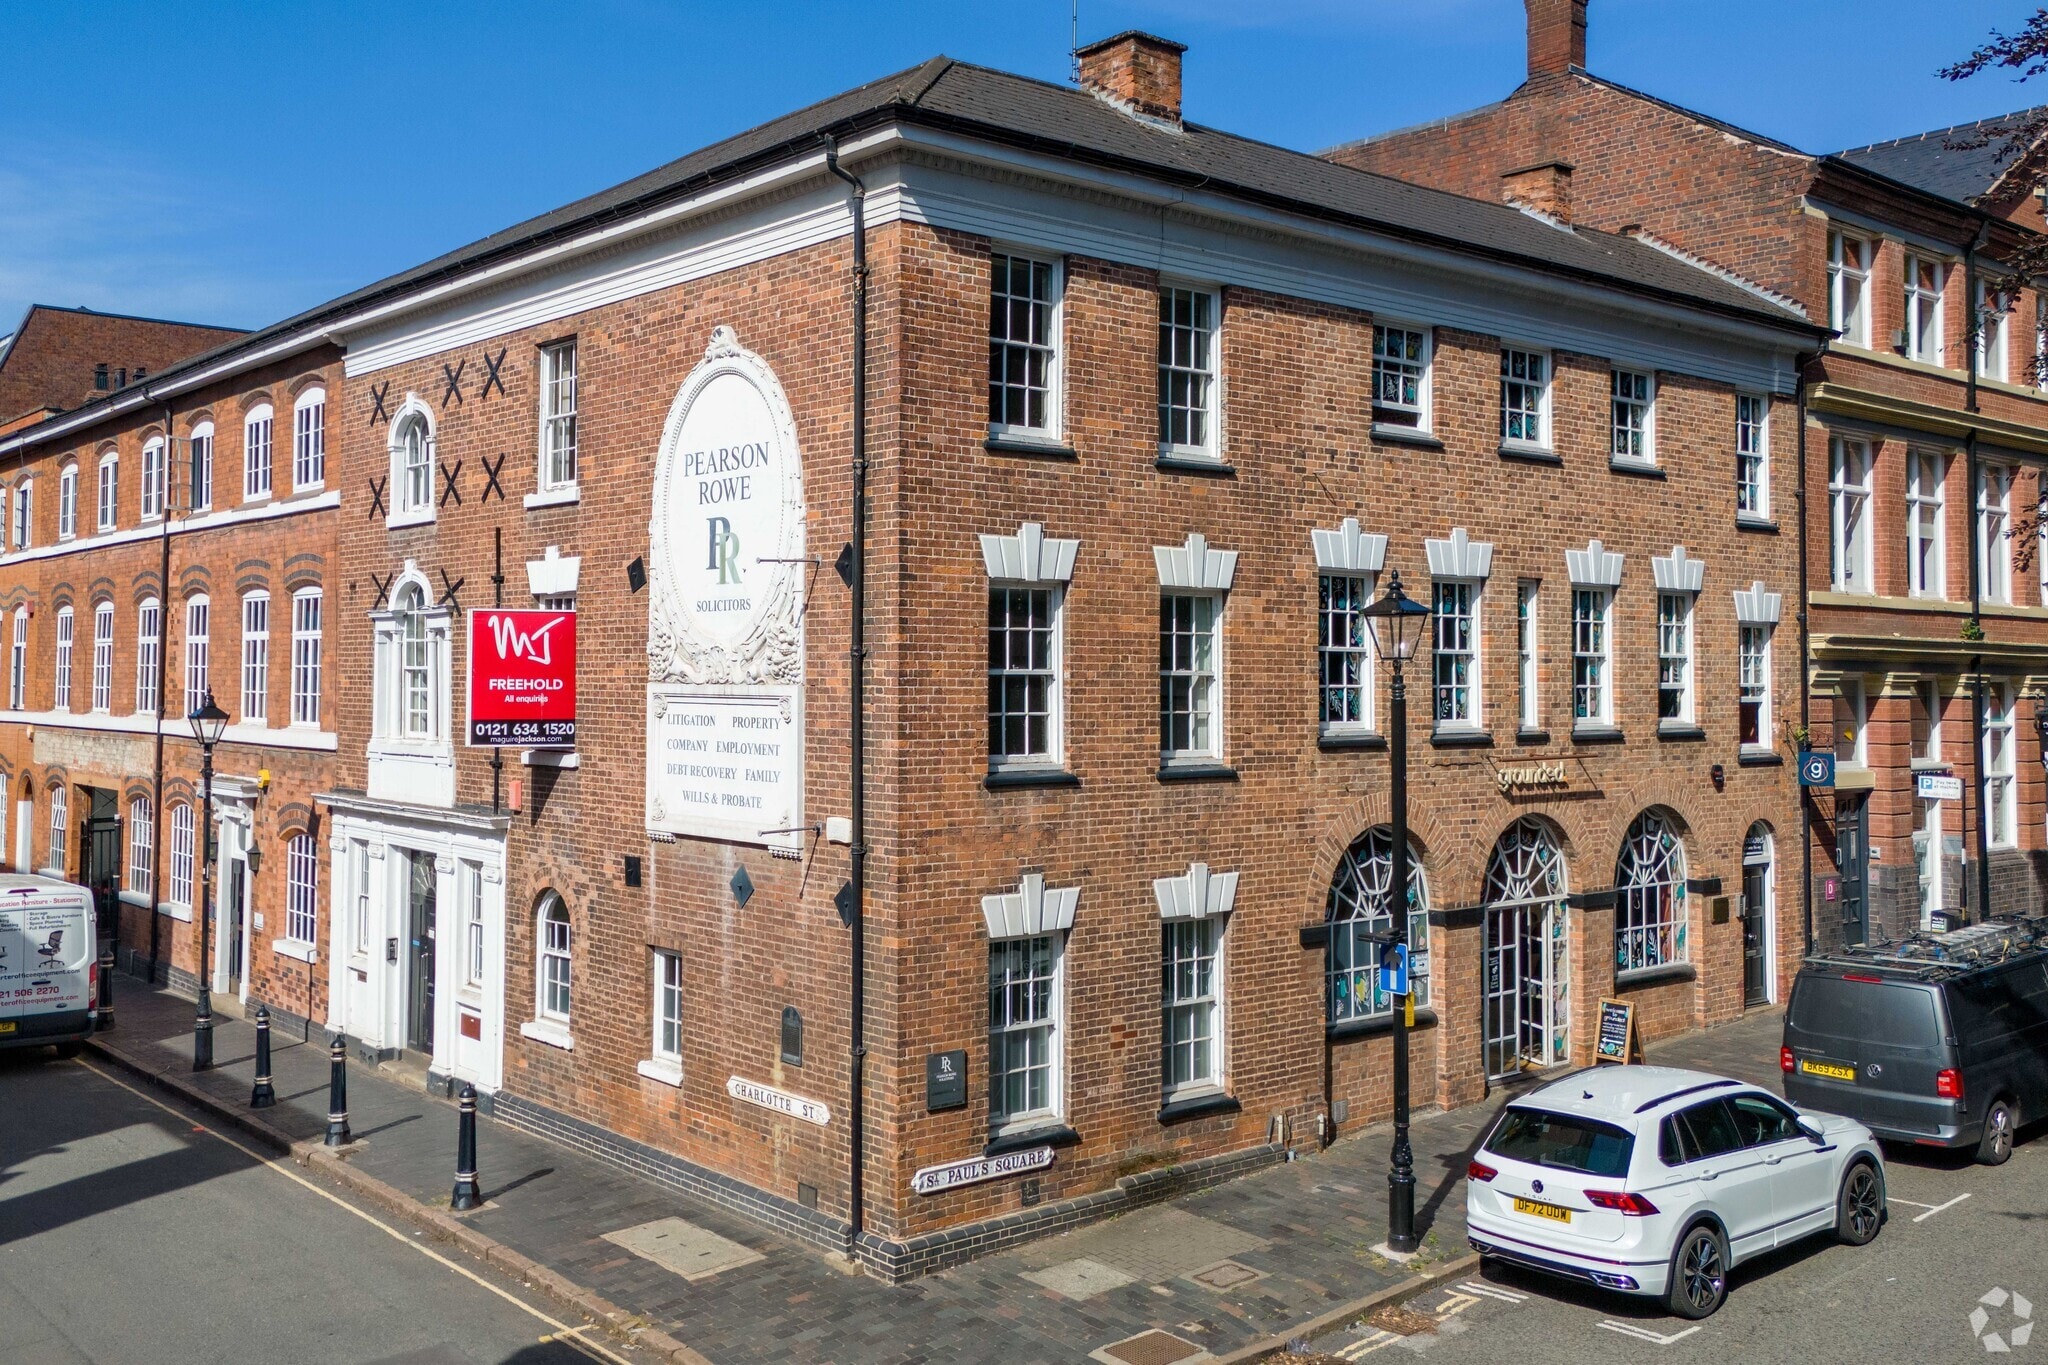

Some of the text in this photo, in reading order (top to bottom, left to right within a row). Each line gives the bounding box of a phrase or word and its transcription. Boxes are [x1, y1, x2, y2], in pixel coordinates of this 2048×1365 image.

[684, 441, 770, 477] PEARSON
[698, 475, 752, 505] ROWE
[696, 598, 751, 612] SOLICITORS
[489, 678, 564, 691] FREEHOLD
[504, 694, 549, 704] All enquiries
[667, 713, 781, 729] LITIGATION PROPERTY
[476, 723, 575, 736] 0121 634 1520
[490, 735, 562, 745] maguirejackson.com
[667, 738, 781, 757] COMPANY EMPLOYMENT
[667, 763, 781, 783] DEBT RECOVERY FAMILY
[1810, 762, 1822, 778] g
[1923, 779, 1932, 789] P
[682, 790, 762, 809] WILLS & PROBATE
[14, 988, 33, 997] 506
[36, 986, 60, 995] 2270
[1831, 1066, 1849, 1078] ZSX
[734, 1083, 815, 1119] CHARLOTTE ST
[947, 1162, 989, 1184] PAUL'S
[995, 1150, 1045, 1173] SQUARE
[1518, 1199, 1567, 1220] DF72 UDW
